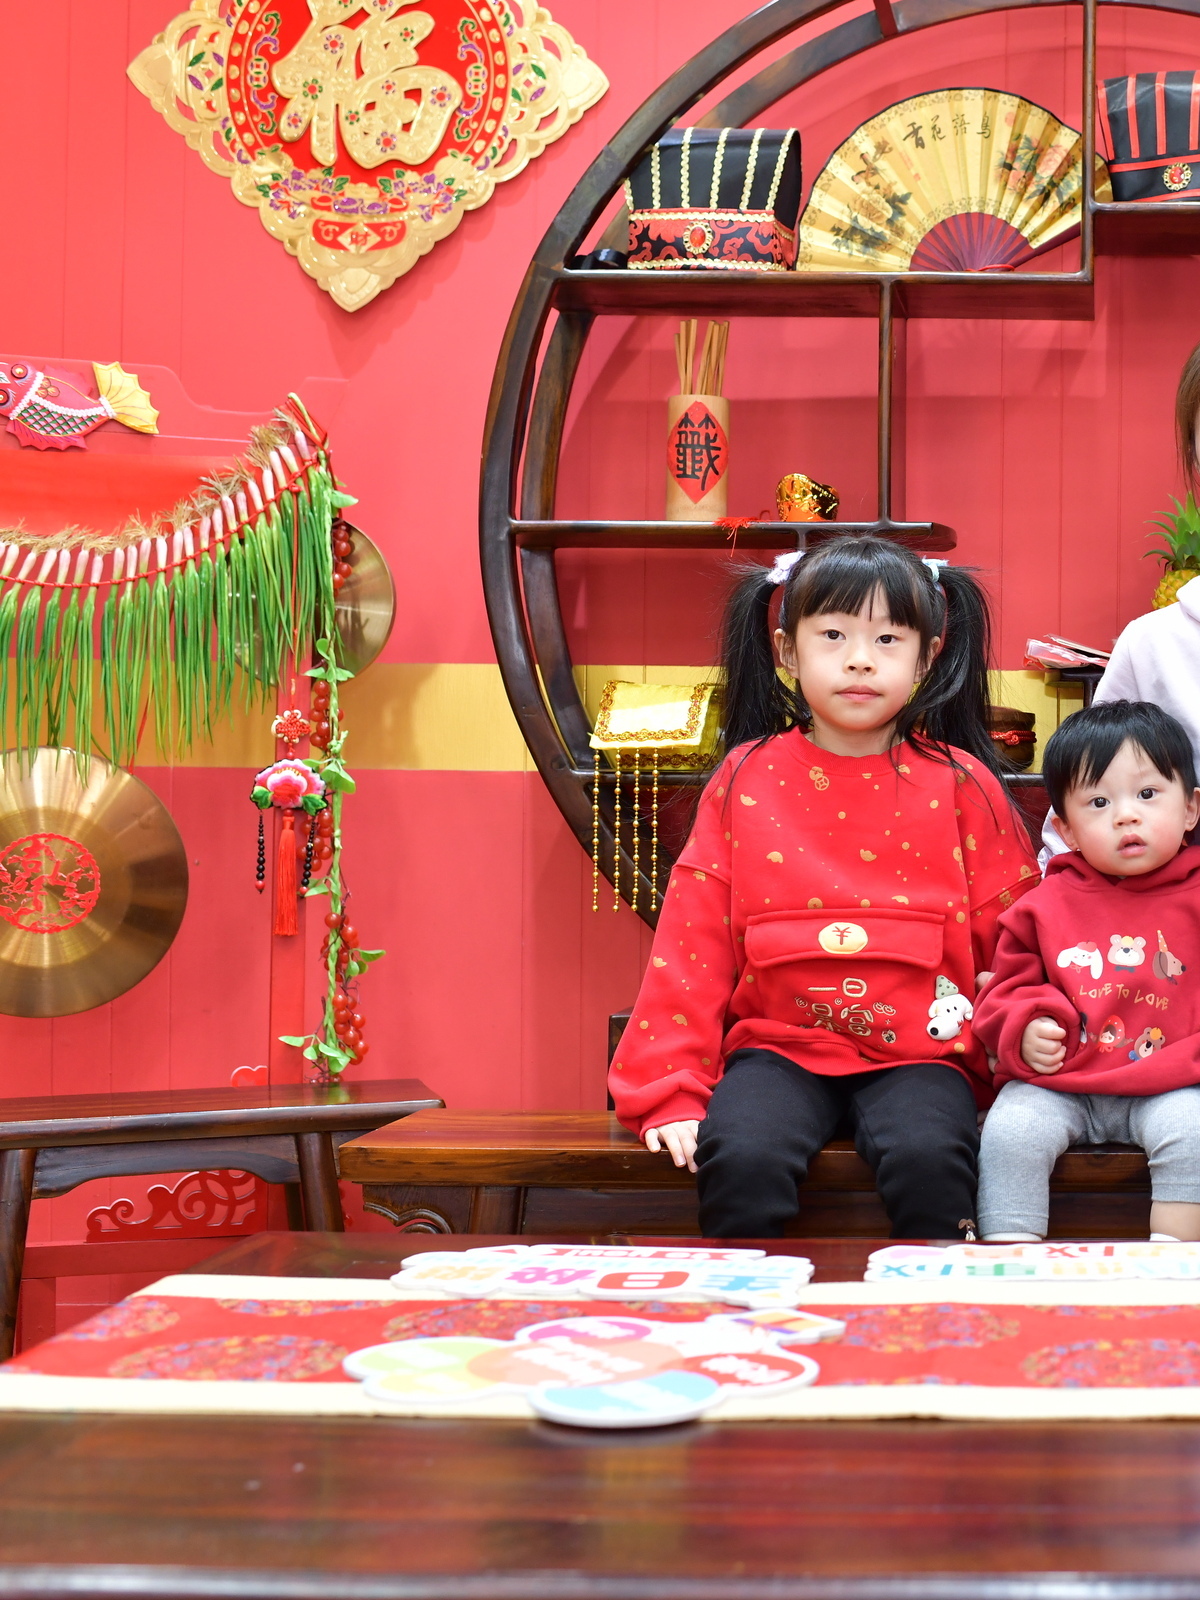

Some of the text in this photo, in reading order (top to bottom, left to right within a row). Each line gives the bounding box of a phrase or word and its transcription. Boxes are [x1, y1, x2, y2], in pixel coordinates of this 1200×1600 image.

[271, 0, 463, 169] 福
[1079, 983, 1169, 1011] LOVE TO LOVE
